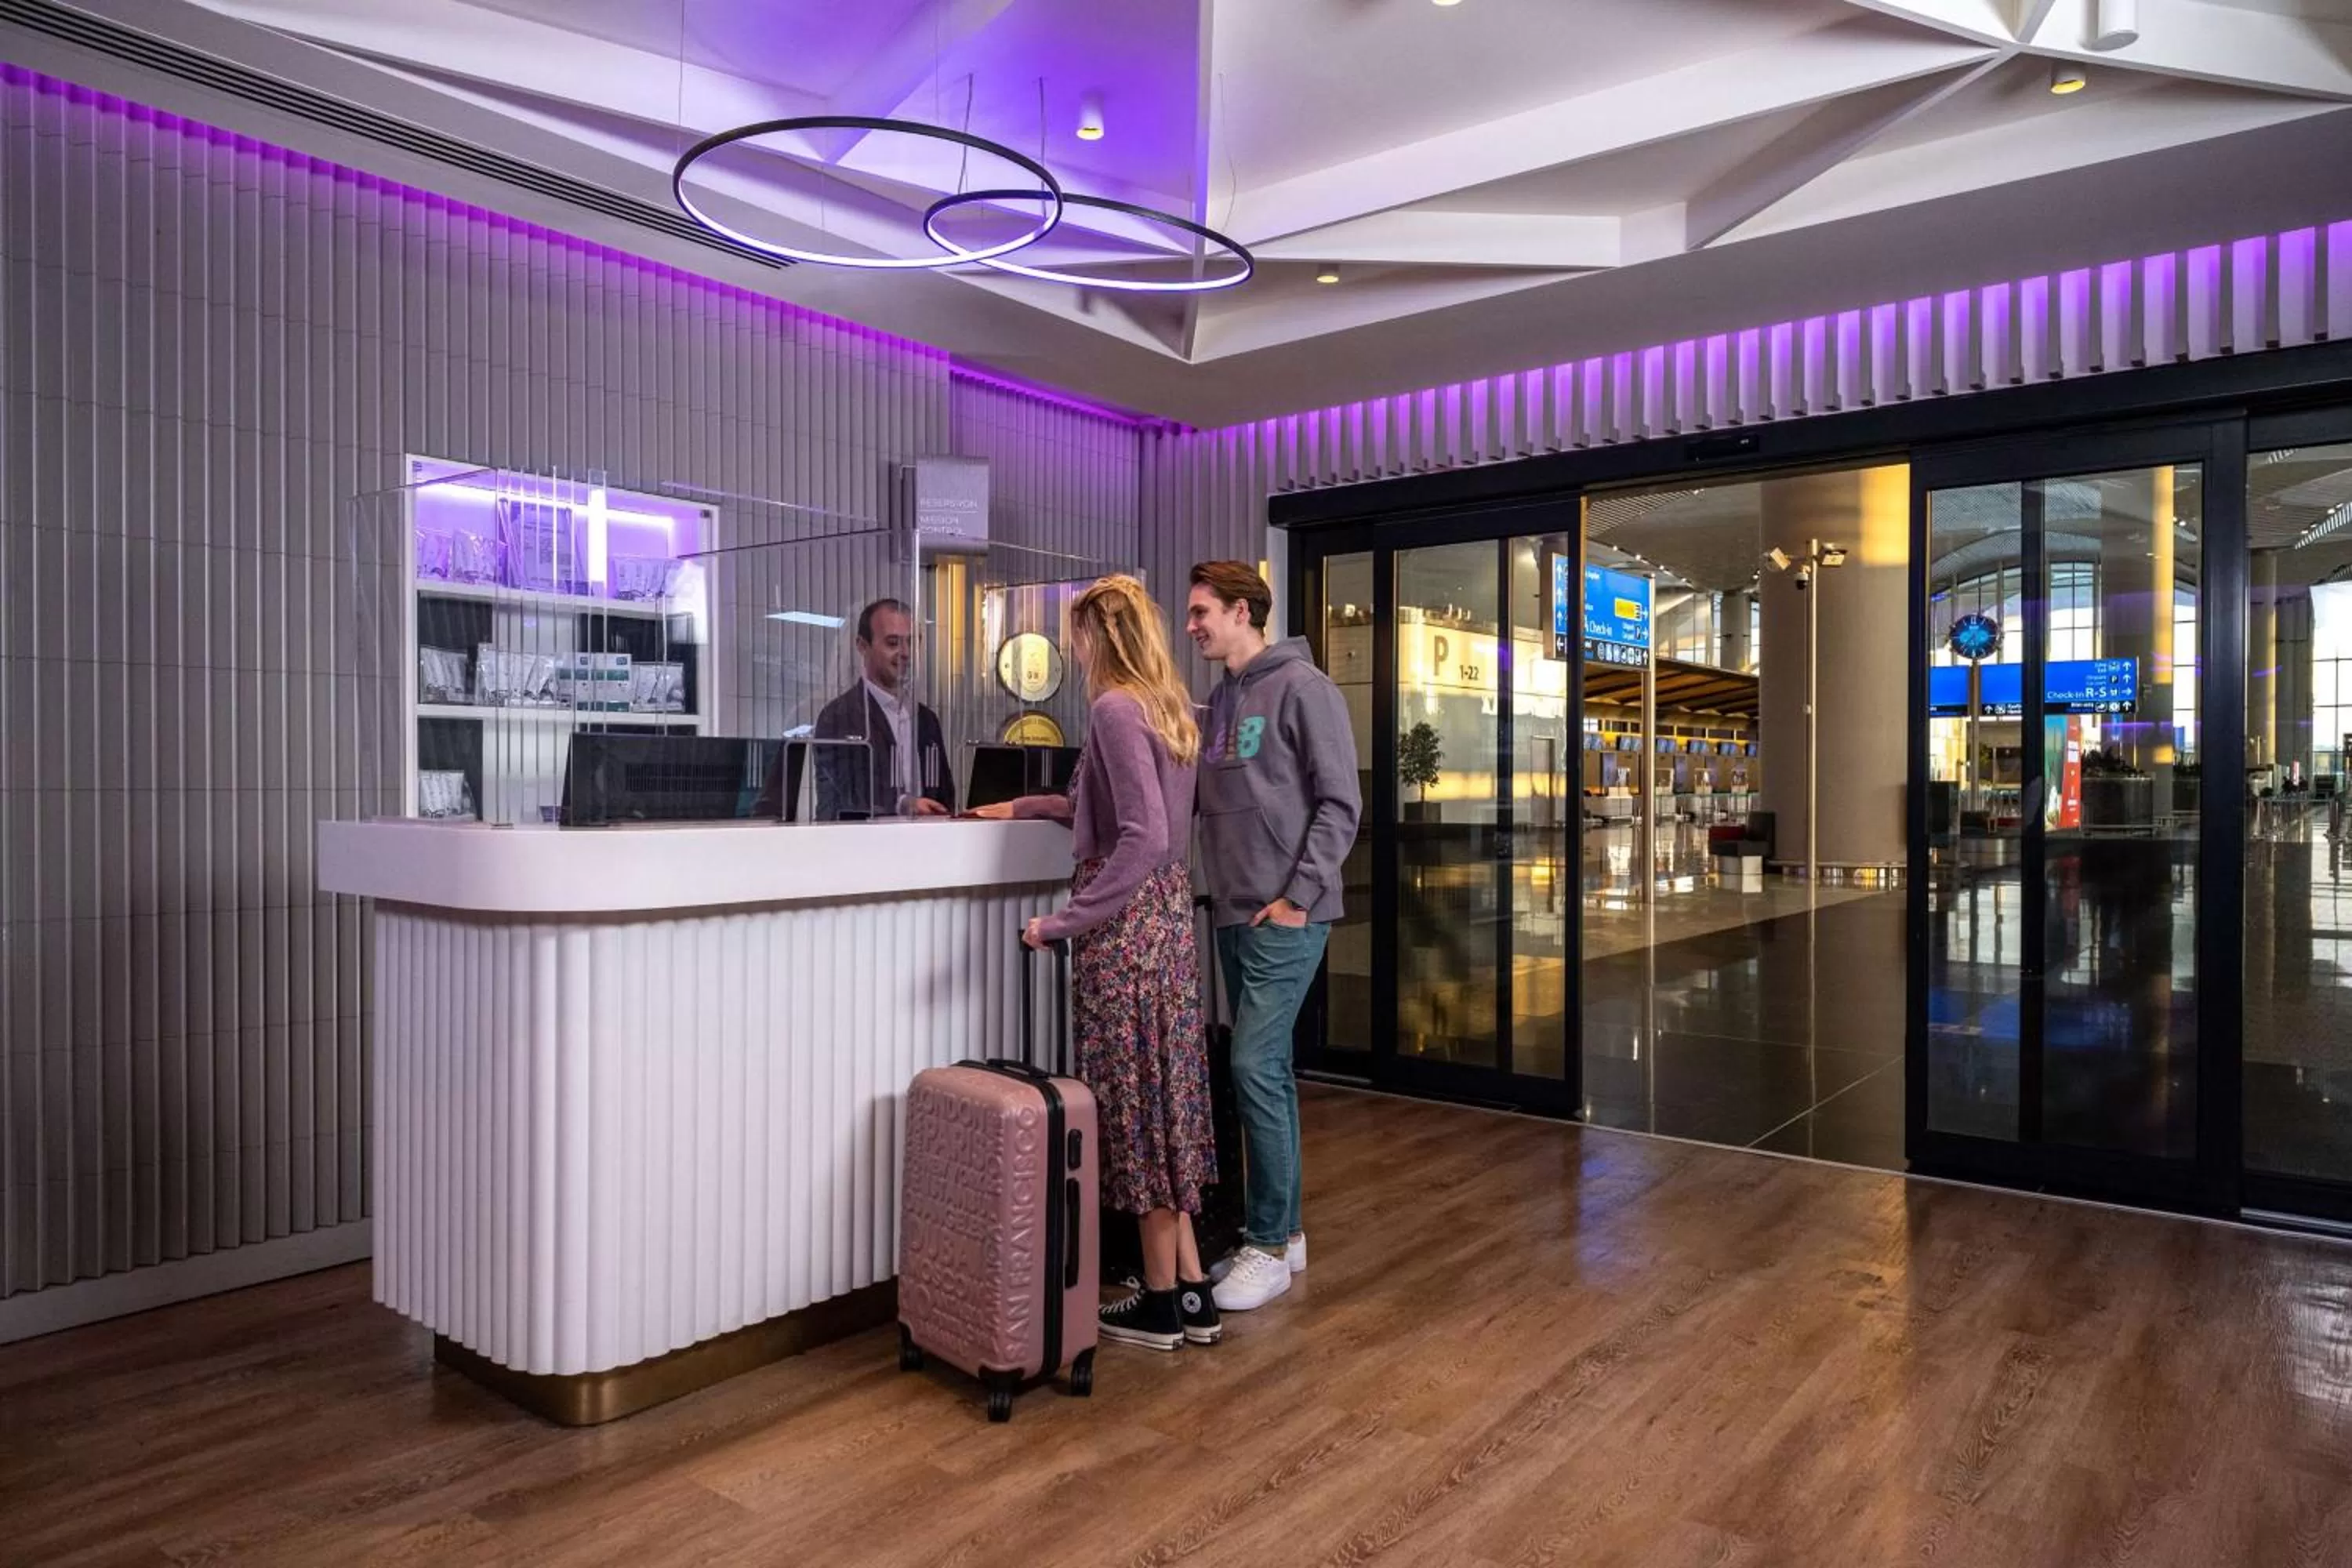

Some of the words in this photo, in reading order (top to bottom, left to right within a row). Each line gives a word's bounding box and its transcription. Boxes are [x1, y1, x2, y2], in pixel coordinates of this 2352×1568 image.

[1433, 634, 1449, 677] P
[1459, 664, 1480, 681] 1-22
[2085, 686, 2107, 699] R-S
[1008, 1105, 1040, 1290] FRANCISCO
[1006, 1294, 1030, 1363] SAN
